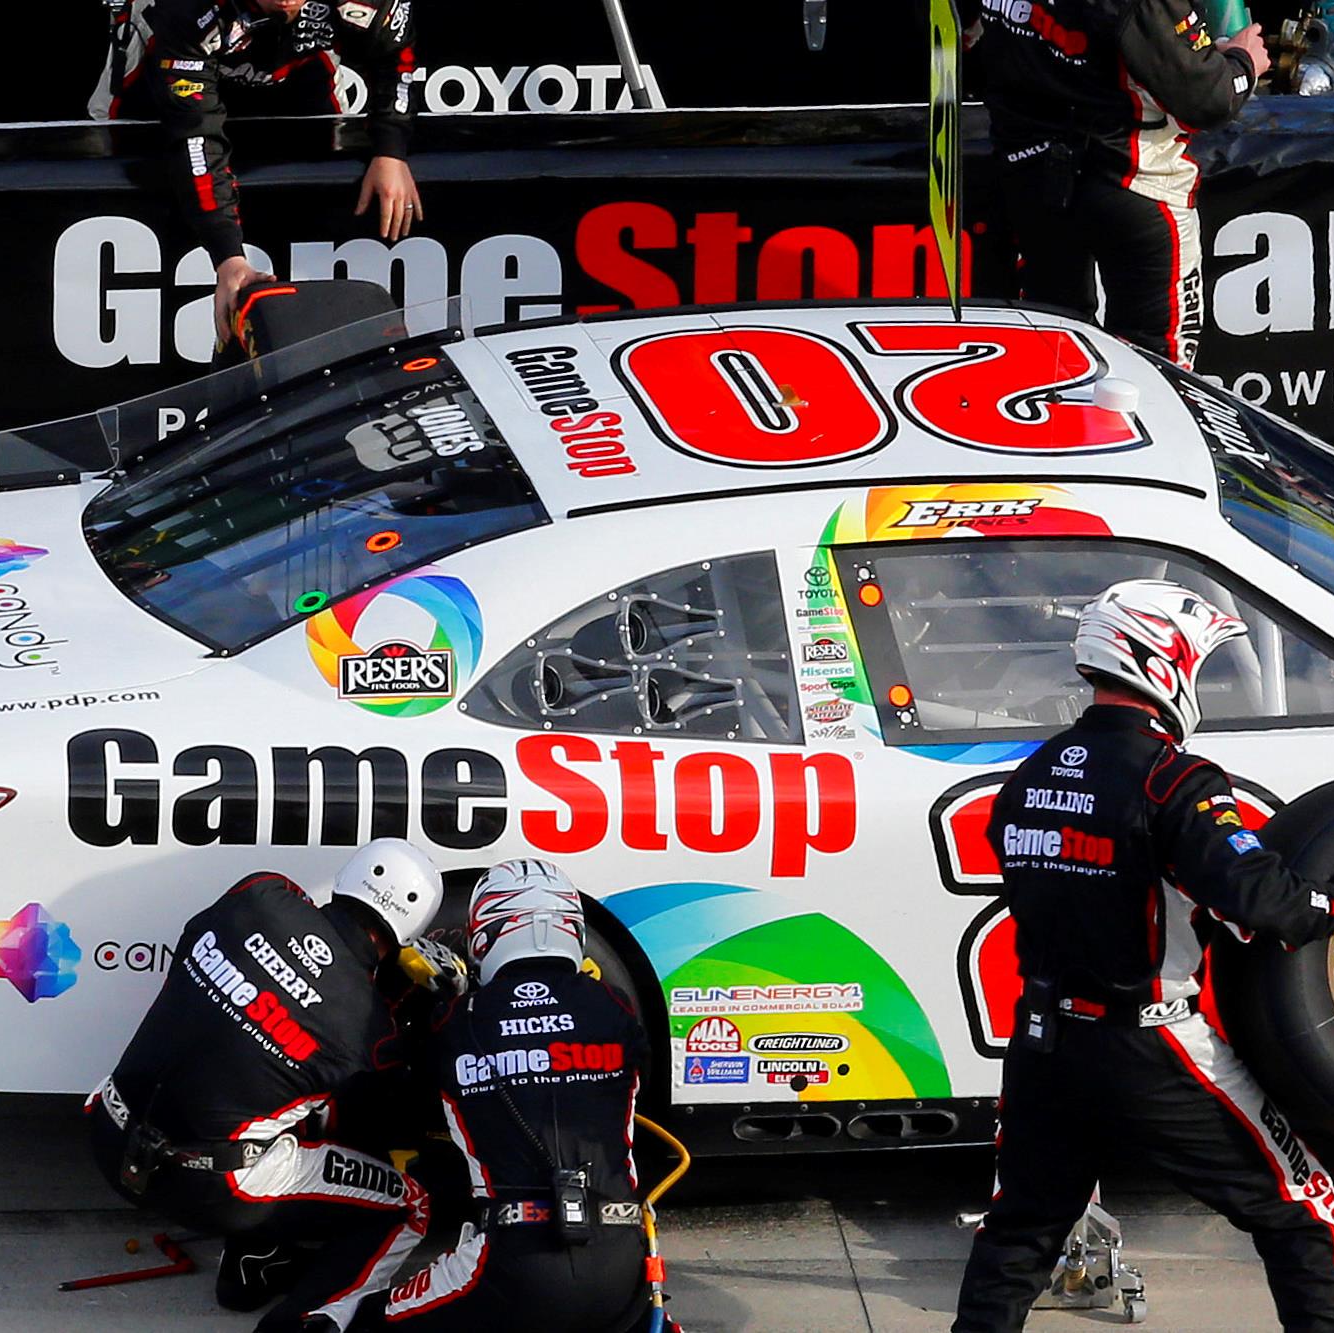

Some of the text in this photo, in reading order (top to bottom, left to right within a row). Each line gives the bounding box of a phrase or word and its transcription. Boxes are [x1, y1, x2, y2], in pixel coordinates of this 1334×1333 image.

[412, 64, 667, 113] OYOTA
[505, 344, 638, 480] GameStop
[413, 402, 486, 457] JONES
[798, 589, 840, 600] TOYOTA
[796, 607, 845, 618] GameStop
[347, 653, 446, 692] RESER'S
[800, 666, 853, 677] Hisense
[392, 682, 421, 690] FOODS
[1051, 765, 1084, 779] TOYOTA
[67, 728, 857, 878] GameStop
[1025, 788, 1095, 815] BOLLING
[1003, 823, 1115, 866] GameStop
[94, 940, 174, 966] can
[286, 937, 323, 979] TOYOTA
[244, 933, 324, 1009] CHERRY
[192, 931, 321, 1062] GameStop
[510, 996, 559, 1009] TOYOTA
[673, 985, 861, 1002] SUNENERGY1
[222, 1003, 243, 1023] the
[673, 1001, 861, 1014] LEADERS IN COMMERCIAL SOLAR
[499, 1013, 575, 1037] HICKS
[691, 1018, 739, 1043] MAC
[689, 1042, 739, 1051] TOOLS
[756, 1036, 841, 1050] FREIGHTLINER
[454, 1041, 624, 1087] GameStop
[759, 1061, 818, 1074] LINCOLN
[511, 1073, 528, 1086] to
[533, 1073, 561, 1084] the
[322, 1149, 406, 1199] Game
